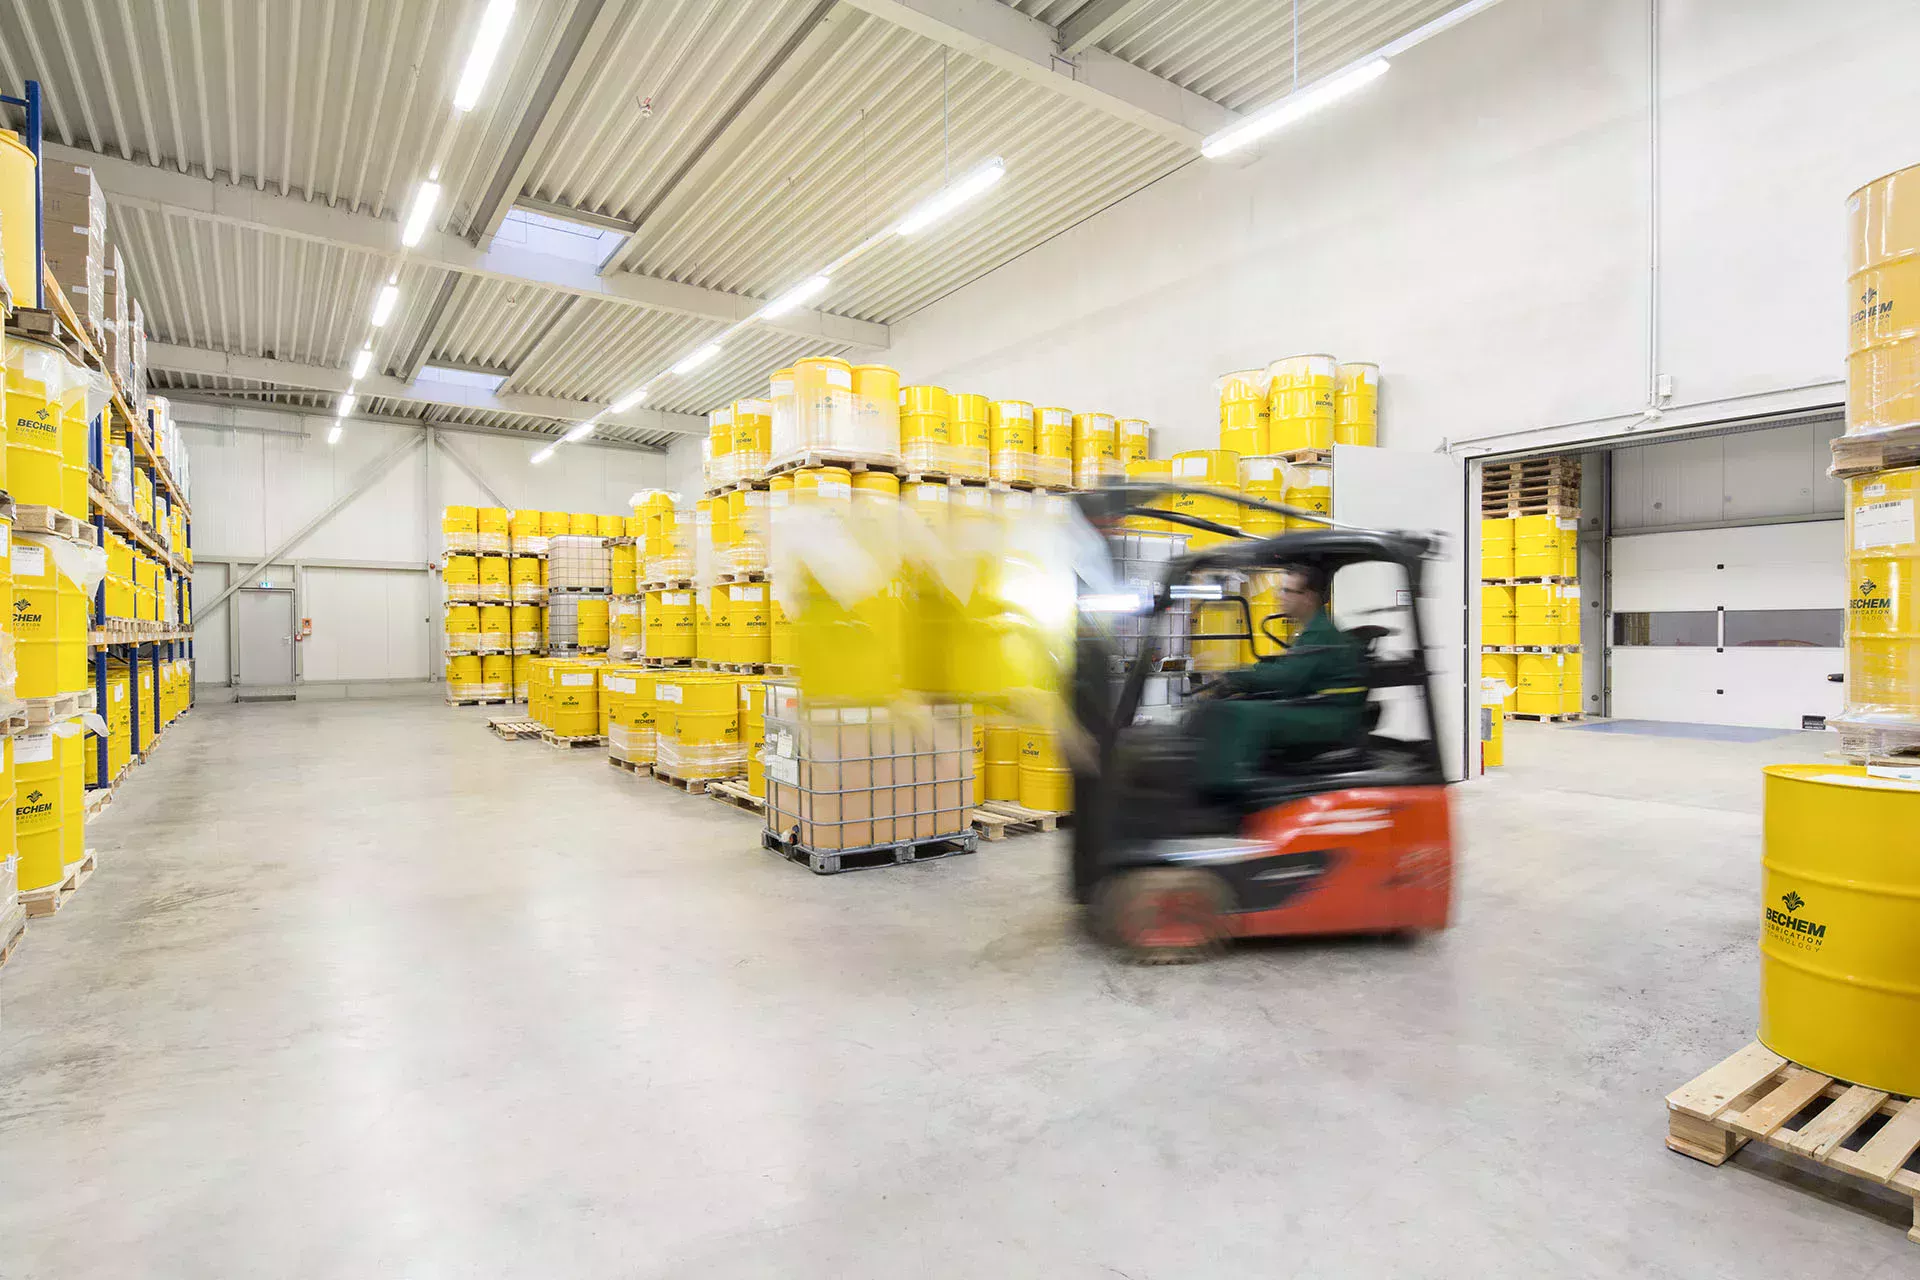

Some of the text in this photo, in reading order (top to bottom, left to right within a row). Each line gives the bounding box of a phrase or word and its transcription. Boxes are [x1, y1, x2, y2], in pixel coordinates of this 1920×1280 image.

[16, 418, 57, 434] BECHEM
[12, 613, 42, 623] CHEM
[16, 802, 52, 816] ECHEM
[1765, 907, 1827, 938] BECHEM
